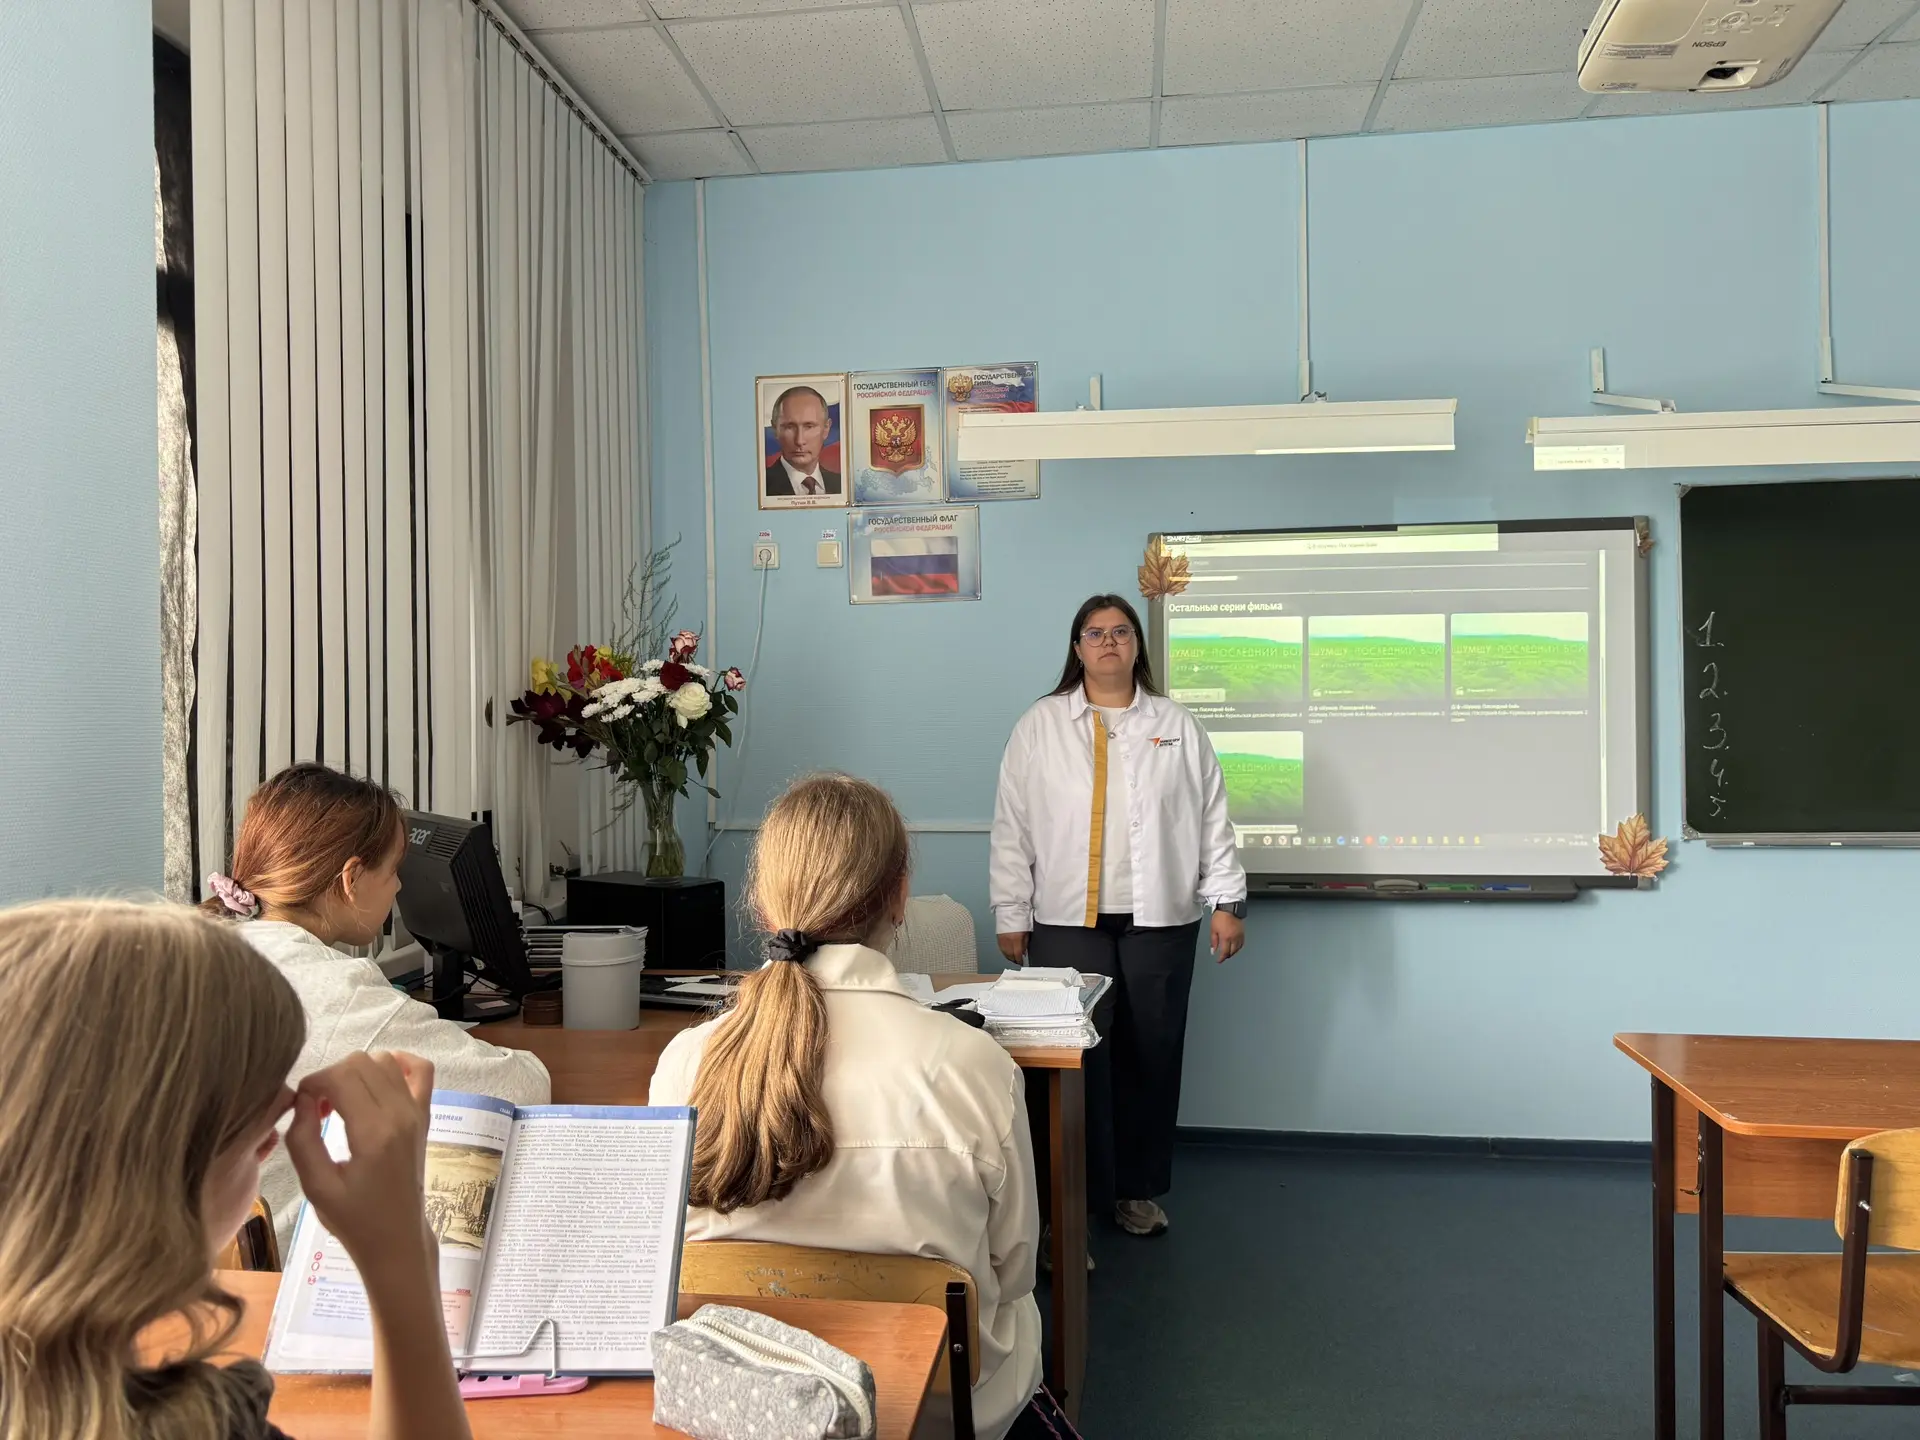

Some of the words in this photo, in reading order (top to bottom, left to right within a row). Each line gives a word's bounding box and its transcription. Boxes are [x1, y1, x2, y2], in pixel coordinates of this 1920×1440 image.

[1691, 40, 1727, 48] EPSON
[853, 379, 919, 390] ГОСУДАРСТВЕННЫЙ
[919, 379, 936, 387] ГЕРБ
[856, 390, 897, 399] РОССИЙСКОЙ
[868, 514, 938, 526] ГОСУДАРСТВЕННЫЙ
[939, 514, 959, 523] ФЛАГ
[874, 524, 915, 533] РОССИЙСКОЙ
[915, 523, 953, 532] ФЕДЕРАЦИИ
[1168, 602, 1218, 613] Остальные
[1219, 603, 1246, 616] серии
[1247, 601, 1283, 613] фильма
[1697, 611, 1725, 647] 1.
[1212, 647, 1277, 657] ПОСЛЕДНИЙ
[1356, 647, 1415, 656] ПОСЛЕДНИЙ
[1420, 646, 1441, 655] БОЙ
[1497, 644, 1559, 653] ПОСЛЕДНИЙ
[1564, 643, 1586, 653] БОЙ
[1699, 662, 1728, 699] 2.
[1703, 712, 1729, 750] 3.
[1710, 758, 1728, 787] 4.
[408, 827, 431, 846] acer
[434, 1113, 463, 1122] времени
